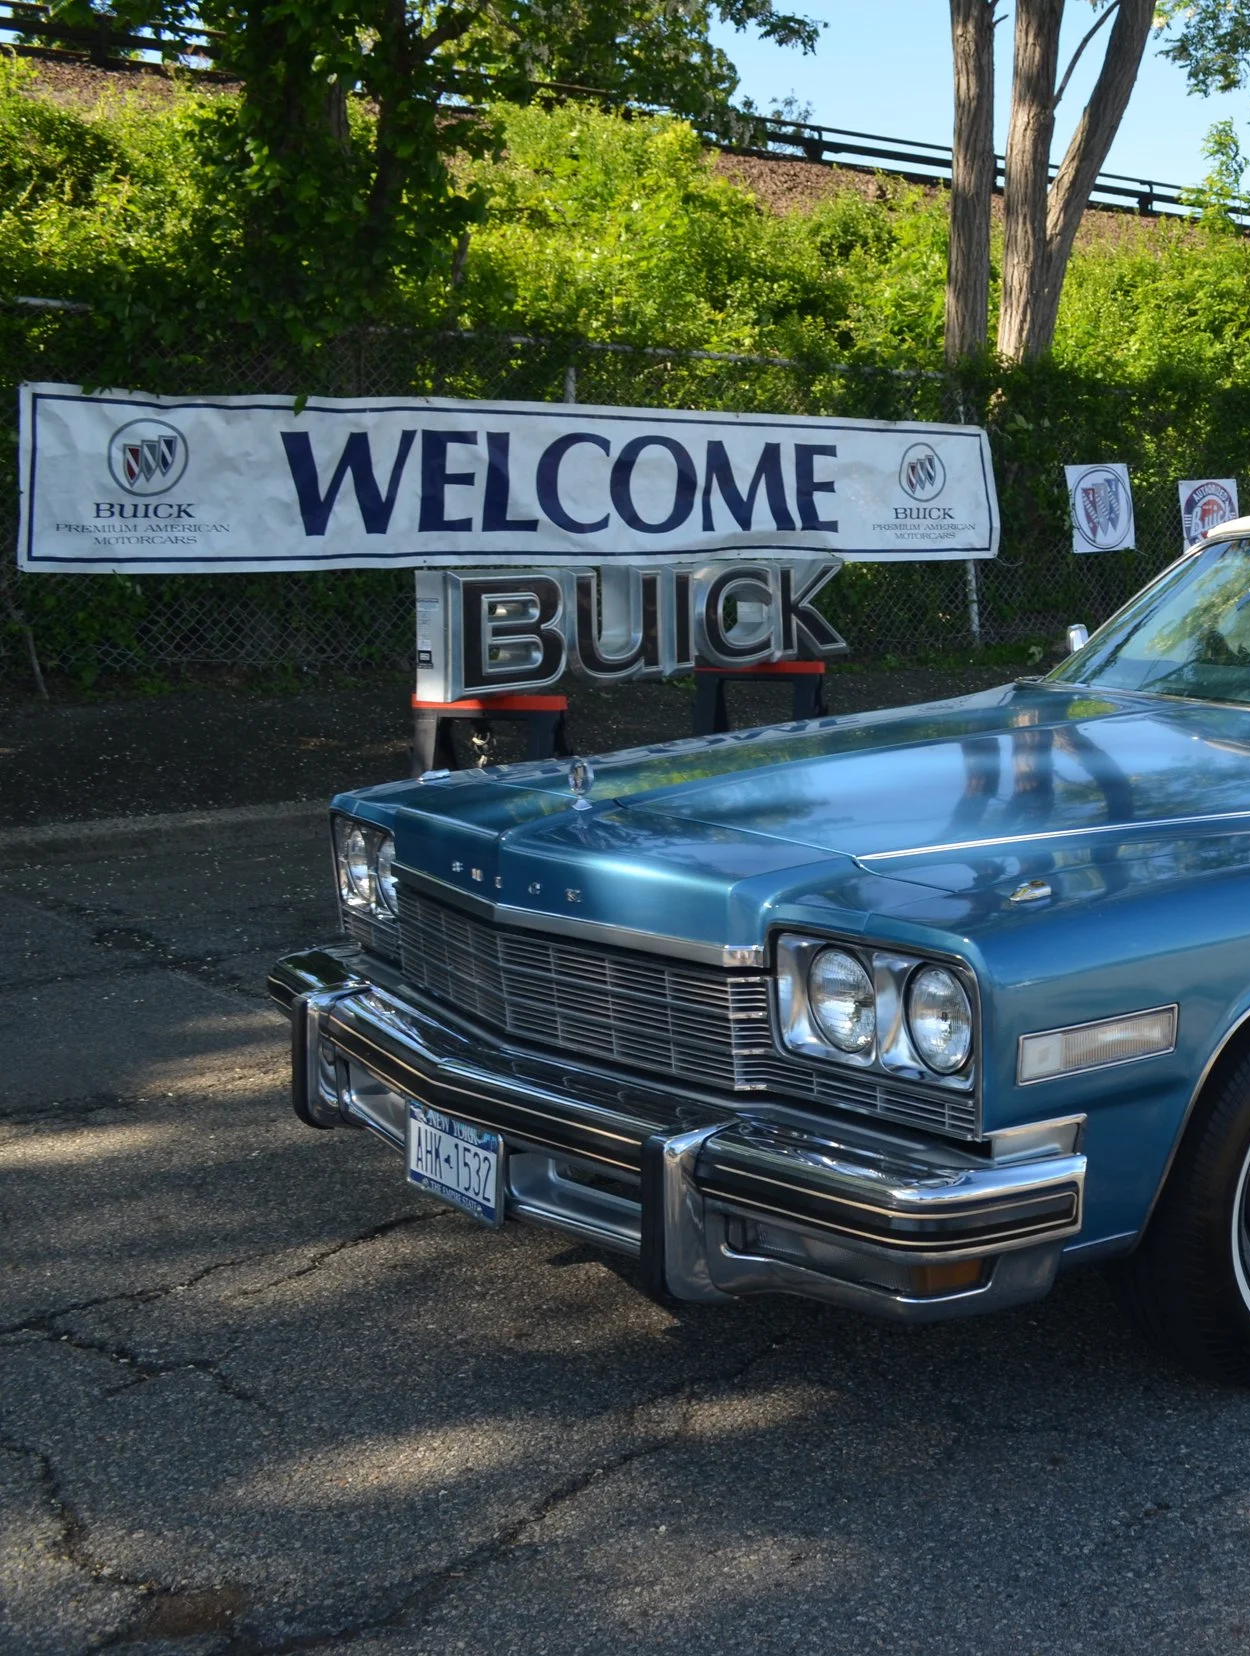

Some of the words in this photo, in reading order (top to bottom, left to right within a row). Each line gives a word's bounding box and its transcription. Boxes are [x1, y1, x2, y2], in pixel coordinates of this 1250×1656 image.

[280, 429, 839, 537] WELCOME
[93, 502, 196, 519] BUICK
[893, 507, 956, 520] BUICK
[55, 523, 138, 534] PREMIUM
[143, 523, 231, 534] AMERICAN
[872, 523, 921, 532] PREMIUM
[923, 523, 977, 531] AMERICAN
[93, 535, 198, 546] MOTORCARS
[894, 532, 957, 541] MOTORCARS
[456, 560, 848, 698] BUICK
[428, 1109, 450, 1133] NEW
[452, 1120, 479, 1144] YORK
[416, 1126, 443, 1179] AHK
[454, 1143, 492, 1203] 1532
